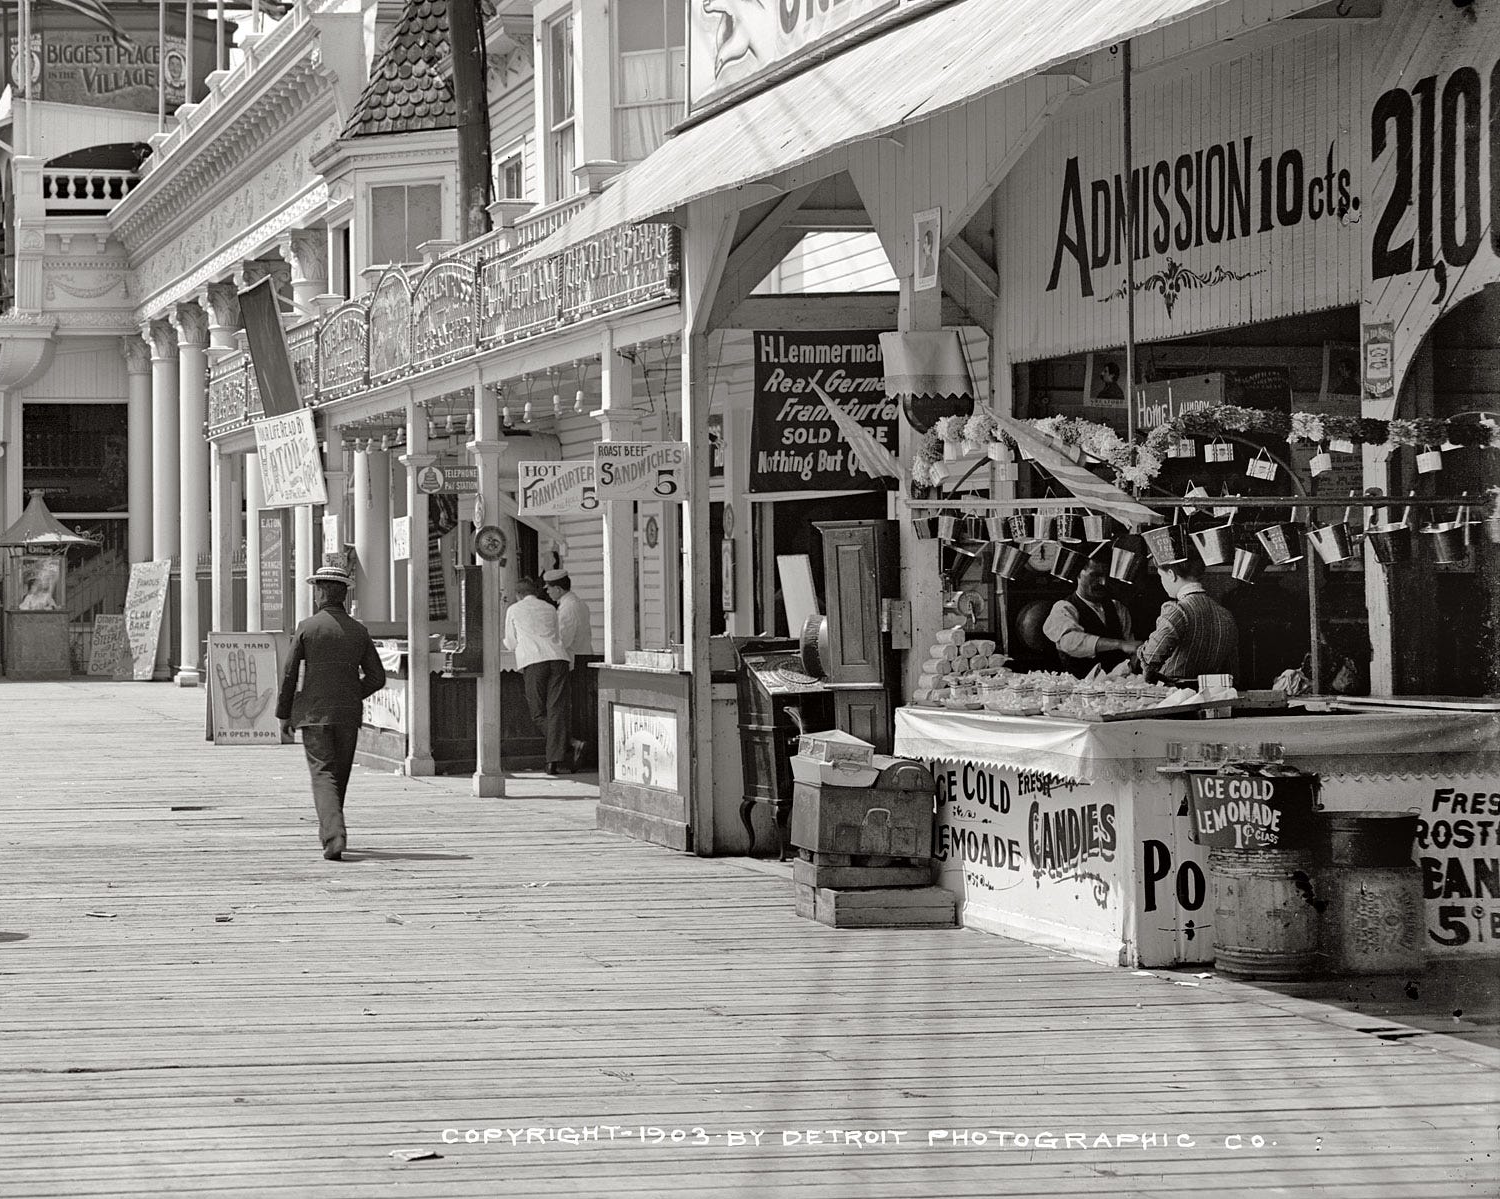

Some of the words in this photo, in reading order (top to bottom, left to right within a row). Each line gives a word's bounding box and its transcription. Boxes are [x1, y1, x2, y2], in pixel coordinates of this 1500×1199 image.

[95, 33, 113, 44] TH
[46, 44, 113, 65] BIGGEST
[1045, 135, 1254, 298] ADMISSION
[1256, 148, 1304, 234] 10
[763, 368, 824, 393] Real
[824, 369, 886, 393] Germa
[781, 427, 831, 444] SOLD
[598, 445, 622, 457] ROAST
[624, 444, 653, 457] BEEF
[444, 469, 478, 478] TELEPHONE
[524, 465, 562, 478] HOT
[601, 448, 683, 486] SANDWICHES
[757, 451, 813, 481] Nothing
[817, 450, 844, 472] But
[456, 481, 479, 490] STATION
[129, 620, 150, 631] BAKE
[962, 760, 1011, 815] COLD
[1017, 771, 1052, 798] FRESH
[1197, 777, 1225, 799] ICE
[1228, 779, 1274, 801] COLD
[1196, 800, 1282, 834] LEMONADE
[1028, 801, 1117, 870] CANDIES
